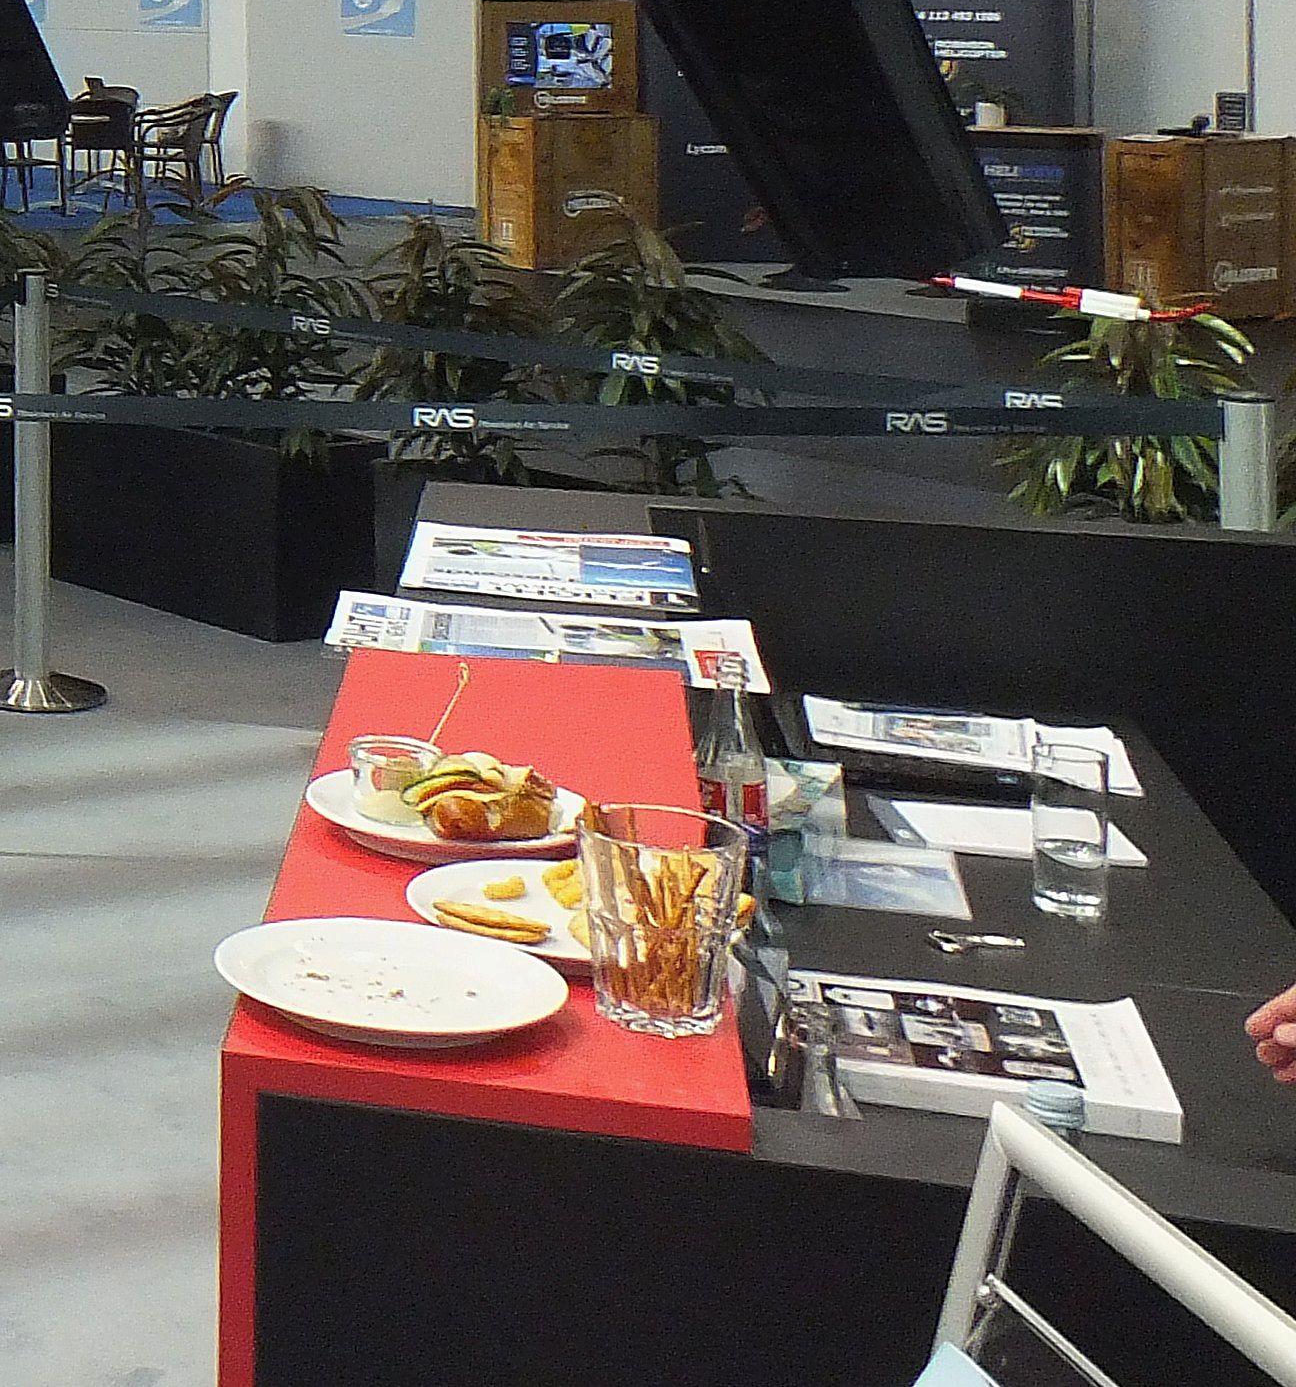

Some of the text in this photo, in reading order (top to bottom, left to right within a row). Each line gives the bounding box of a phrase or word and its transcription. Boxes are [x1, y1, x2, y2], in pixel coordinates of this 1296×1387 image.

[291, 315, 331, 335] RAS
[612, 352, 660, 374] RAS
[412, 406, 476, 429] RAS
[885, 412, 949, 433] RAS
